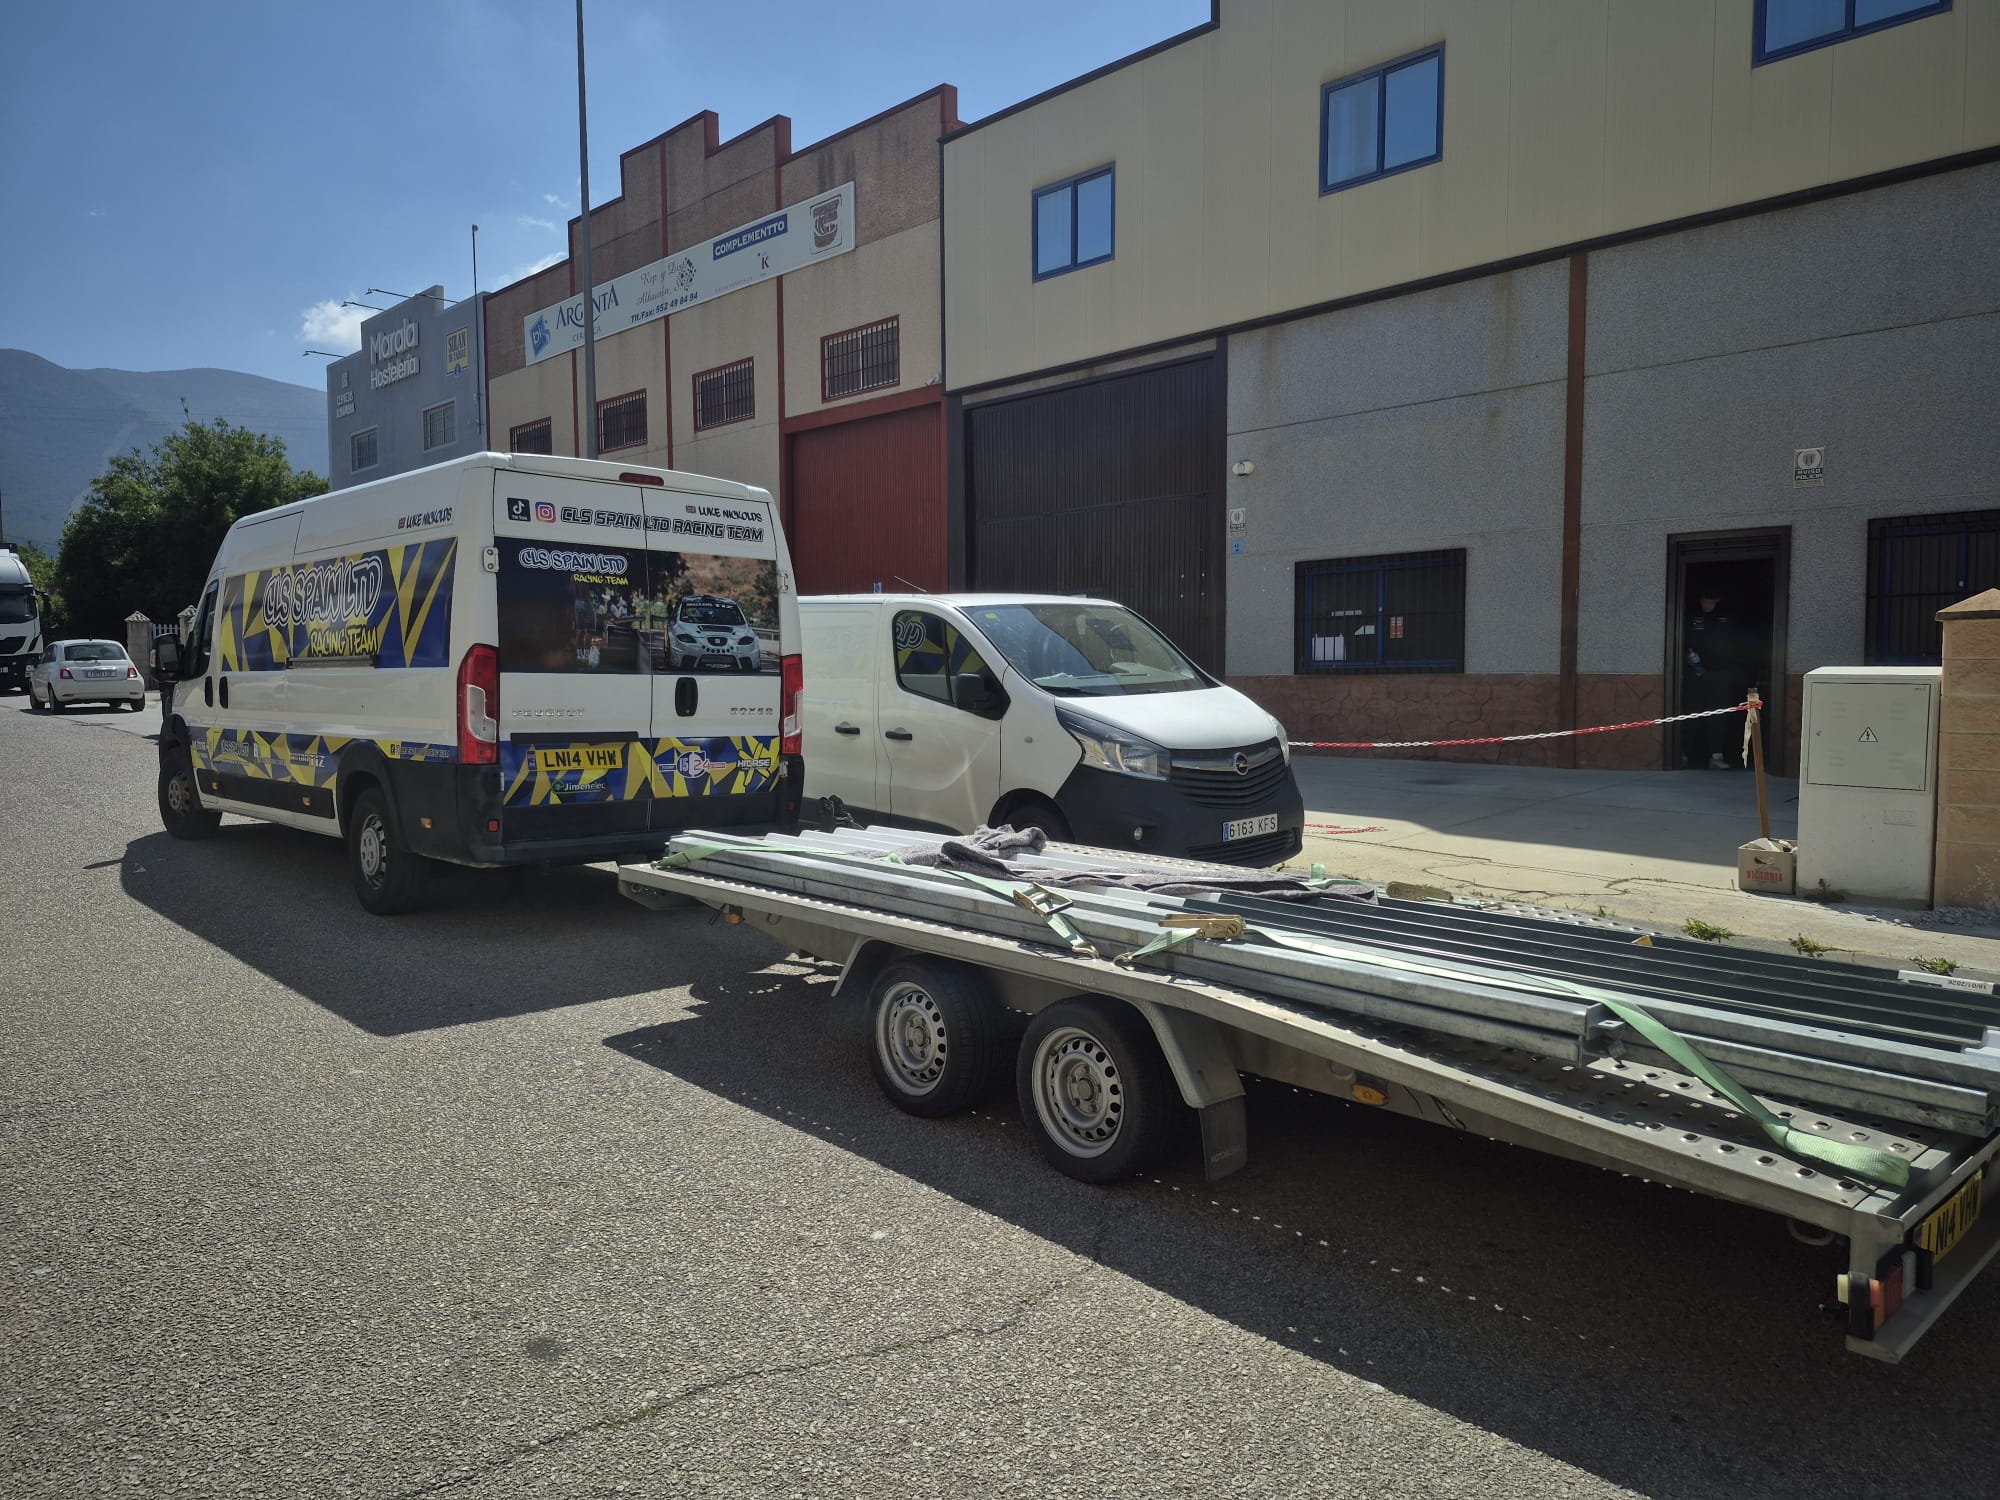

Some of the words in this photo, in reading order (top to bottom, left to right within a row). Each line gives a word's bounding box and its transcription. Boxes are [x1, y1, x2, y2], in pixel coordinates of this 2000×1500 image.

[714, 220, 785, 256] COMPLEMENTTO
[556, 283, 619, 330] ARGNTA
[655, 302, 668, 314] 952
[698, 505, 721, 518] LUKE
[561, 507, 593, 526] CLS
[594, 510, 642, 530] SPAIN
[643, 515, 671, 532] LTD
[672, 518, 725, 538] RACING
[726, 524, 764, 542] TEAM
[519, 547, 550, 570] CLS
[550, 550, 597, 573] SPAIN
[597, 553, 628, 575] LTD
[573, 574, 603, 585] RACING
[605, 575, 629, 586] TEAM
[263, 571, 292, 628] CLS
[291, 562, 342, 626] SPAIN
[340, 555, 383, 621] LTD
[309, 628, 347, 656] RACING
[346, 625, 379, 656] TEAM
[730, 707, 774, 716] BOXER
[543, 750, 581, 768] LN14
[585, 749, 617, 766] VHW
[564, 781, 606, 791] Jimenelec
[1229, 820, 1254, 838] 6163
[1258, 817, 1276, 833] KFS
[1745, 869, 1784, 883] VICTORIA
